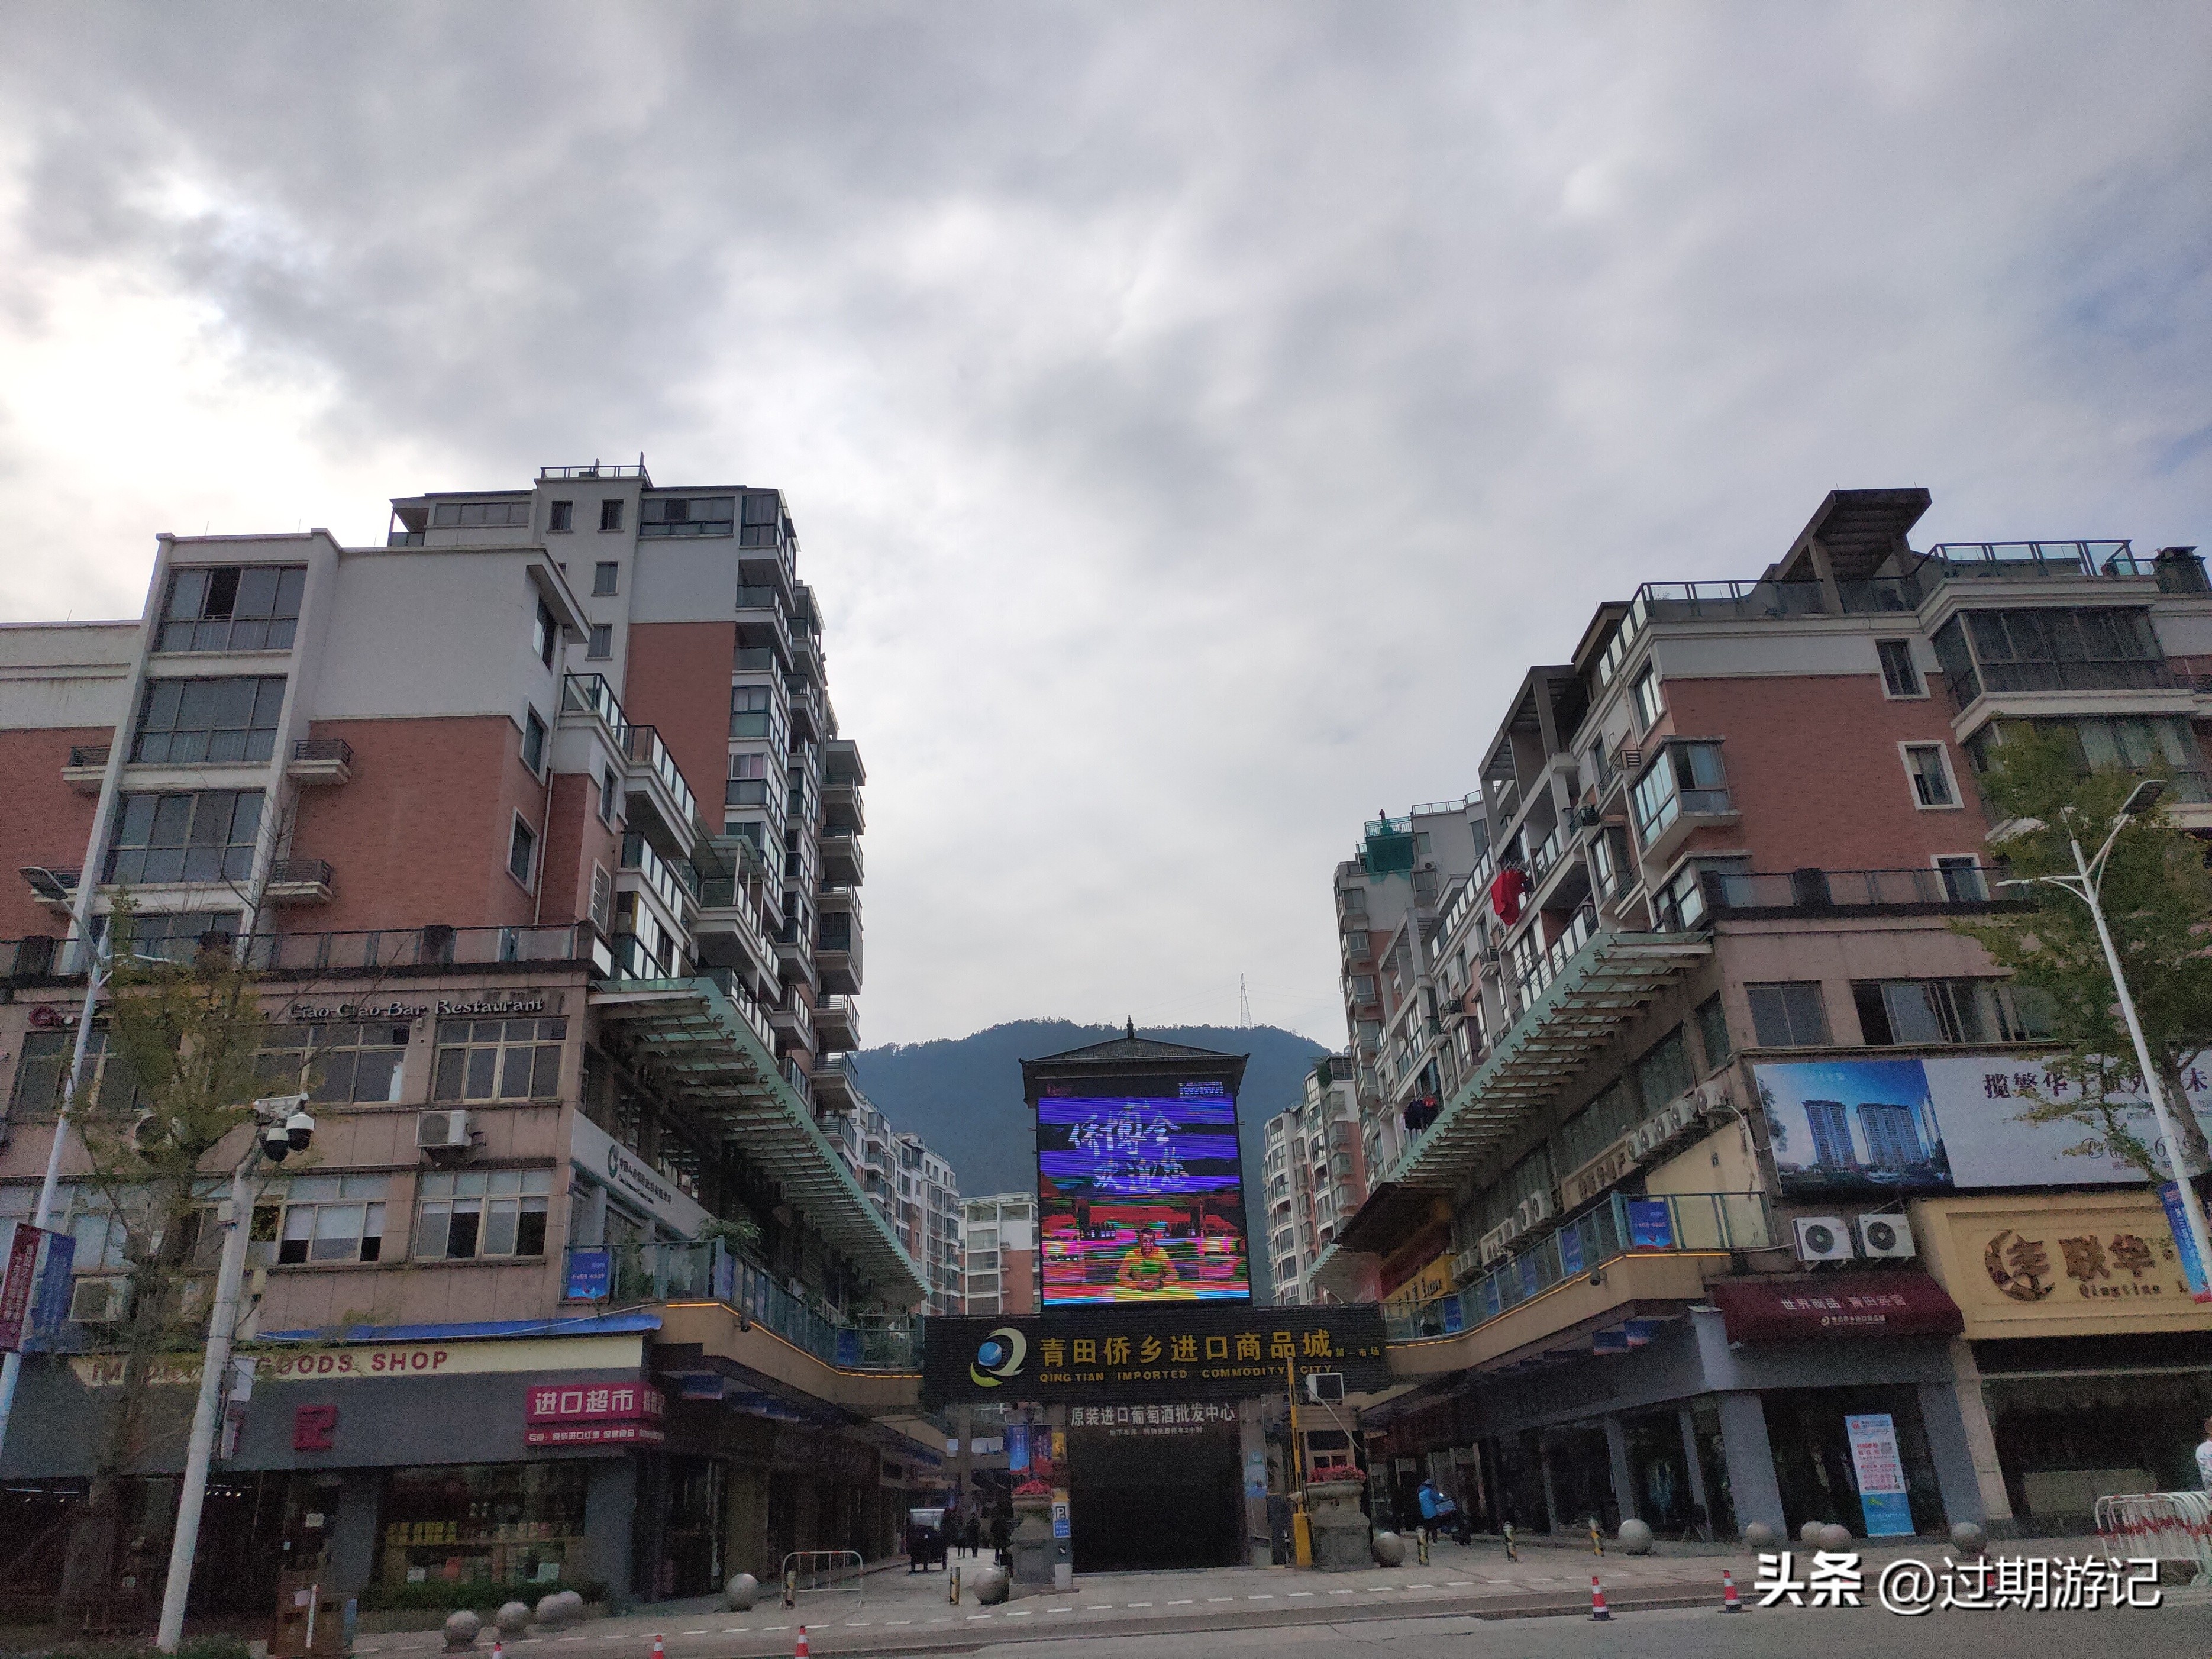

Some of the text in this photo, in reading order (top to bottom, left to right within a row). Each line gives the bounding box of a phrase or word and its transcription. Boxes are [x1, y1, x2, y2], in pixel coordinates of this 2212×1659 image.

[435, 998, 544, 1015] Restaurant
[1093, 1147, 1190, 1193] 欢迎您
[1781, 1297, 1841, 1309] 世界商品
[1039, 1329, 1380, 1367] 青田侨乡进口商品城 第一市场
[372, 1351, 448, 1372] SHOP
[1118, 1370, 1187, 1381] IMPORTED
[1202, 1366, 1285, 1379] COMMODITY
[1300, 1364, 1333, 1375] CITY
[534, 1389, 634, 1415] 进口超市
[1071, 1403, 1235, 1426] 原装进口葡萄酒批发中心
[1056, 1506, 1065, 1518] P
